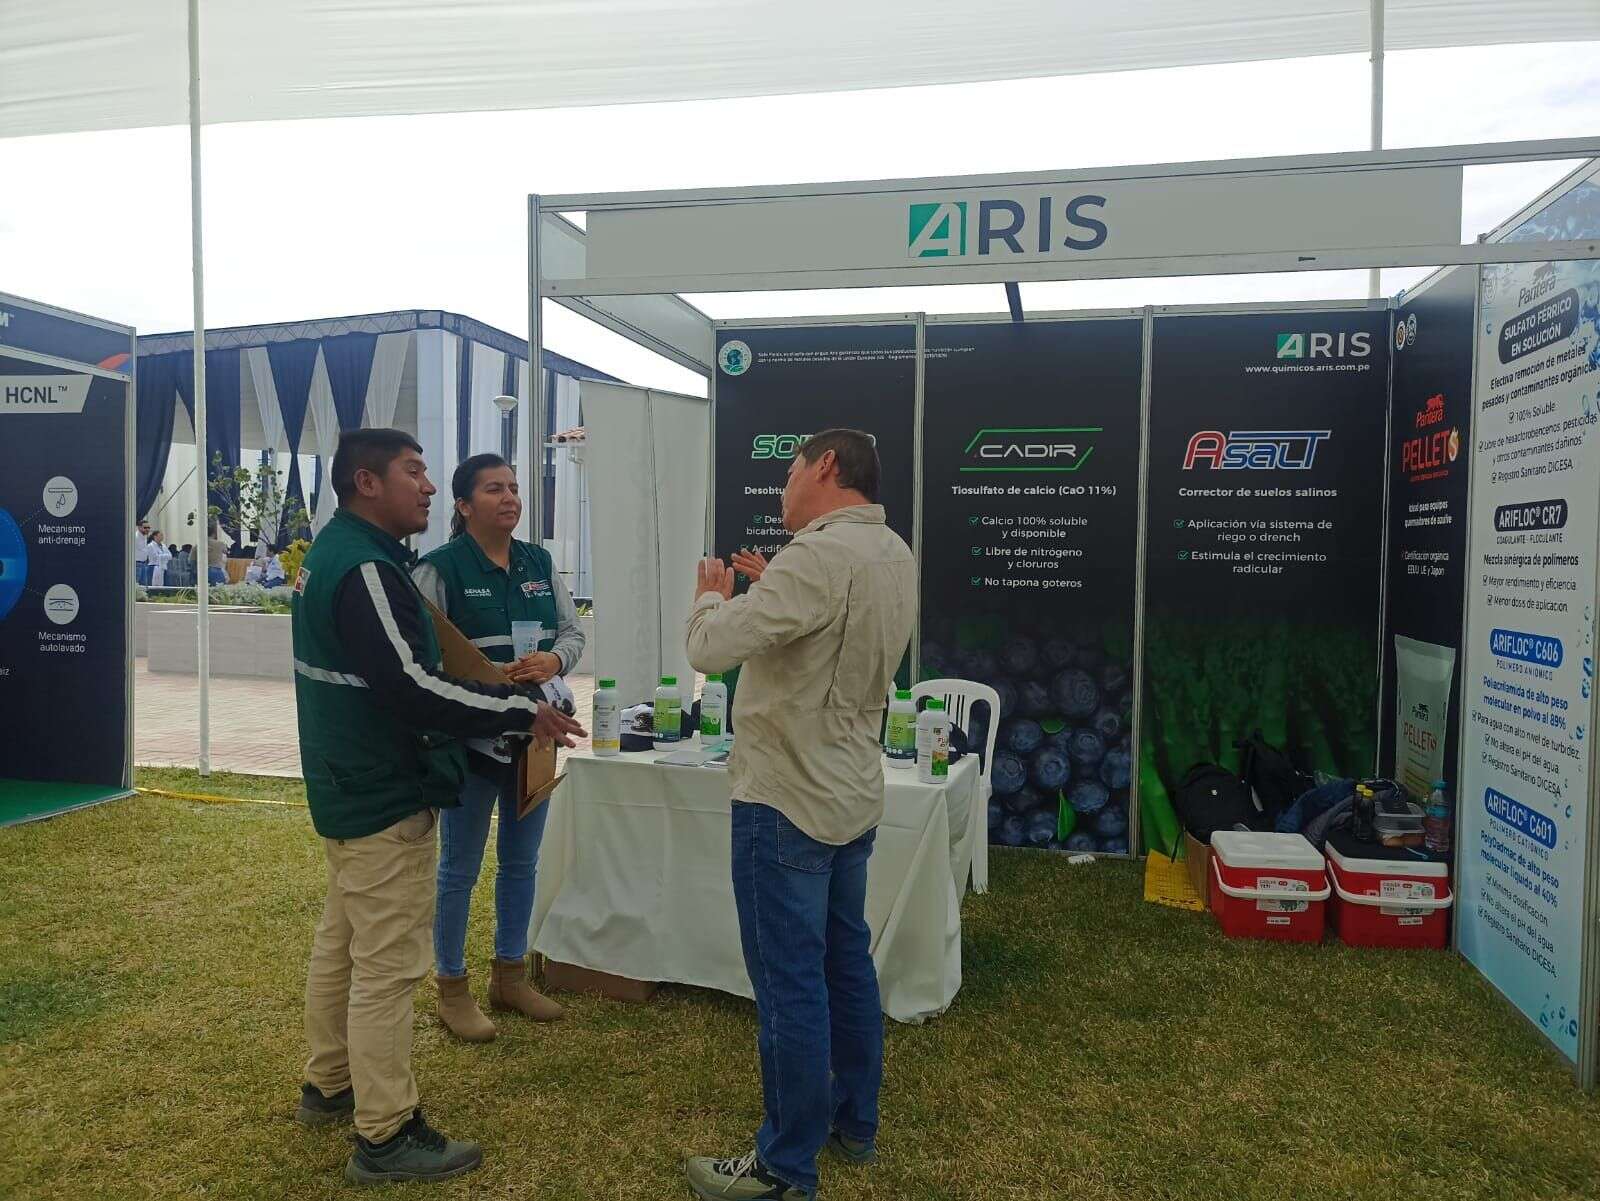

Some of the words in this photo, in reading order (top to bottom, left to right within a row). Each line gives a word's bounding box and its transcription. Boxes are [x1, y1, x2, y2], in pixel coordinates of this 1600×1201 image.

[908, 195, 1108, 258] ARIS
[1504, 314, 1535, 341] SULFATO
[1537, 296, 1572, 328] FÉRRICO
[1276, 332, 1371, 358] ARIS
[1511, 341, 1521, 357] EN
[1523, 322, 1561, 353] SOLUCIÓN
[1245, 363, 1370, 374] www.quimicos.aris.com.pe
[1490, 369, 1513, 390] Efectiva
[1546, 355, 1555, 369] de
[1556, 343, 1586, 366] metales
[1481, 394, 1504, 412] pesados
[1510, 374, 1559, 400] contaminantes
[980, 444, 1077, 458] CADIR
[744, 486, 784, 495] Desobtu
[952, 486, 1004, 495] Tiosulfato
[1007, 486, 1021, 495] de
[1023, 486, 1056, 495] calcio
[1058, 485, 1085, 496] (CaO
[1088, 485, 1117, 496] 11%)
[1178, 488, 1233, 497] Corrector
[1236, 488, 1251, 497] de
[1254, 488, 1292, 497] suelos
[1295, 488, 1337, 497] salinos
[981, 516, 1014, 526] Calcio
[1017, 516, 1047, 526] 100%
[1049, 516, 1088, 526] soluble
[1542, 505, 1562, 525] CR7
[38, 524, 86, 534] Mecanismo
[1188, 519, 1247, 530] Aplicación
[1249, 519, 1266, 529] vía
[1269, 520, 1314, 529] sistema
[1317, 520, 1332, 529] de
[38, 535, 86, 546] anti-drenaje
[1001, 531, 1008, 539] y
[1010, 528, 1067, 540] disponible
[1217, 532, 1246, 543] riego
[1249, 534, 1256, 542] o
[1259, 533, 1301, 542] drench
[985, 546, 1011, 556] Libre
[1014, 547, 1027, 556] de
[1030, 546, 1083, 559] nitrógeno
[1191, 551, 1241, 561] Estimula
[1243, 551, 1254, 561] el
[1257, 551, 1327, 562] crecimiento
[1007, 561, 1013, 570] y
[1016, 560, 1059, 569] cloruros
[1532, 553, 1541, 566] de
[1232, 564, 1283, 574] radicular
[984, 577, 999, 586] No
[1002, 578, 1039, 589] tapona
[1042, 578, 1082, 589] goteros
[1505, 577, 1540, 590] rendimiento
[1545, 578, 1577, 591] eficiencia
[1494, 596, 1511, 607] Menor
[1526, 598, 1535, 609] de
[38, 631, 87, 642] Mecanismo
[40, 643, 86, 653] autolavado
[1535, 641, 1559, 662] C606
[1525, 688, 1535, 701] de
[1535, 690, 1549, 705] alto
[1551, 696, 1568, 710] peso
[1483, 695, 1512, 713] molecular
[1513, 704, 1521, 714] en
[1522, 706, 1541, 722] polvo
[1542, 712, 1549, 724] al
[1550, 713, 1567, 730] 89%
[1477, 712, 1489, 726] Para
[1541, 735, 1550, 748] de
[1490, 737, 1498, 747] No
[1515, 746, 1521, 757] el
[1522, 749, 1531, 761] pH
[1532, 753, 1542, 766] del
[1543, 759, 1560, 775] agua
[1529, 815, 1552, 844] C601
[1518, 854, 1526, 867] de
[1527, 859, 1541, 877] alto
[1541, 870, 1560, 889] peso
[1481, 848, 1509, 874] molecular
[1533, 881, 1541, 896] al
[1541, 886, 1559, 909] 40%
